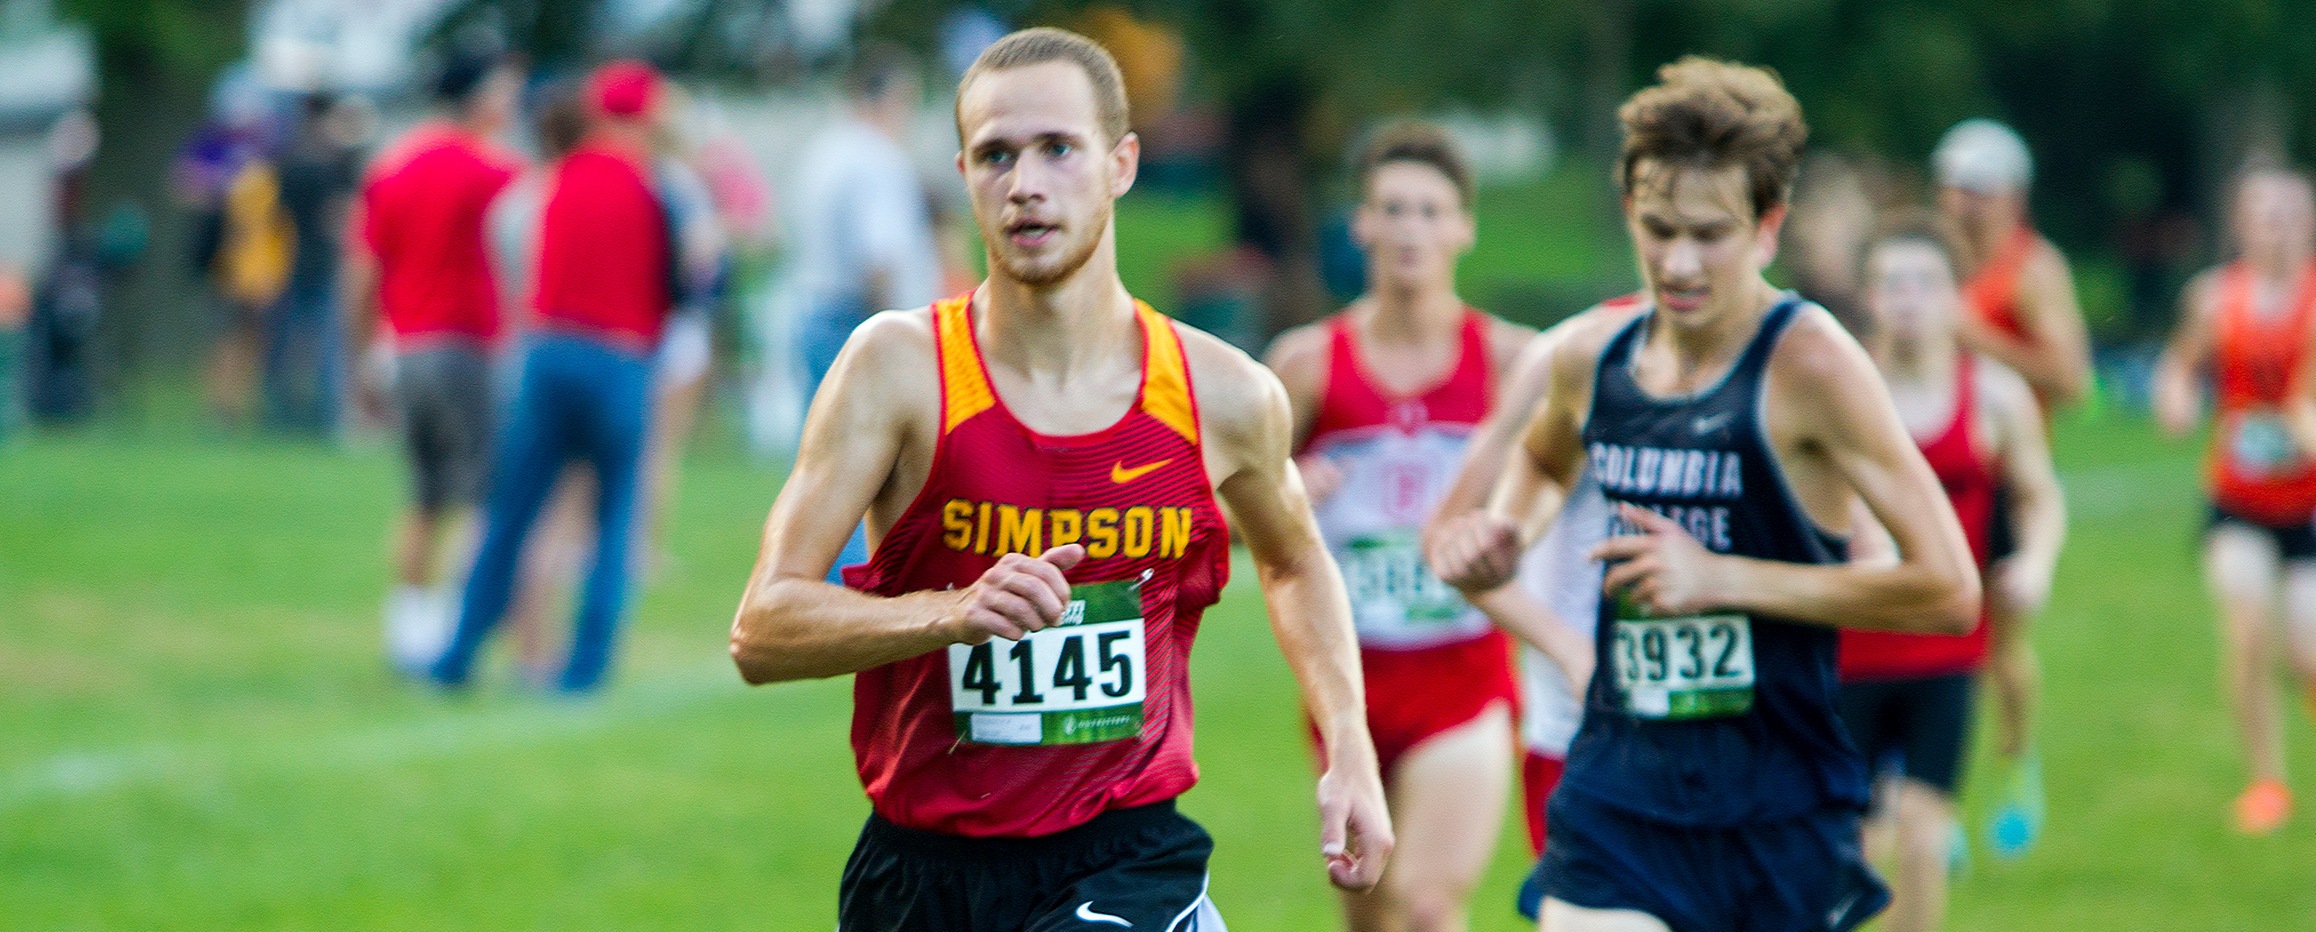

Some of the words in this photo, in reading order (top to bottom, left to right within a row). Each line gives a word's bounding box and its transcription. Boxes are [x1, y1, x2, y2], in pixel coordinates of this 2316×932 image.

[1591, 442, 1743, 496] COLUMBIA
[942, 498, 1193, 560] SIMPSON
[961, 630, 1133, 705] 4145
[1617, 622, 1744, 682] 3932
